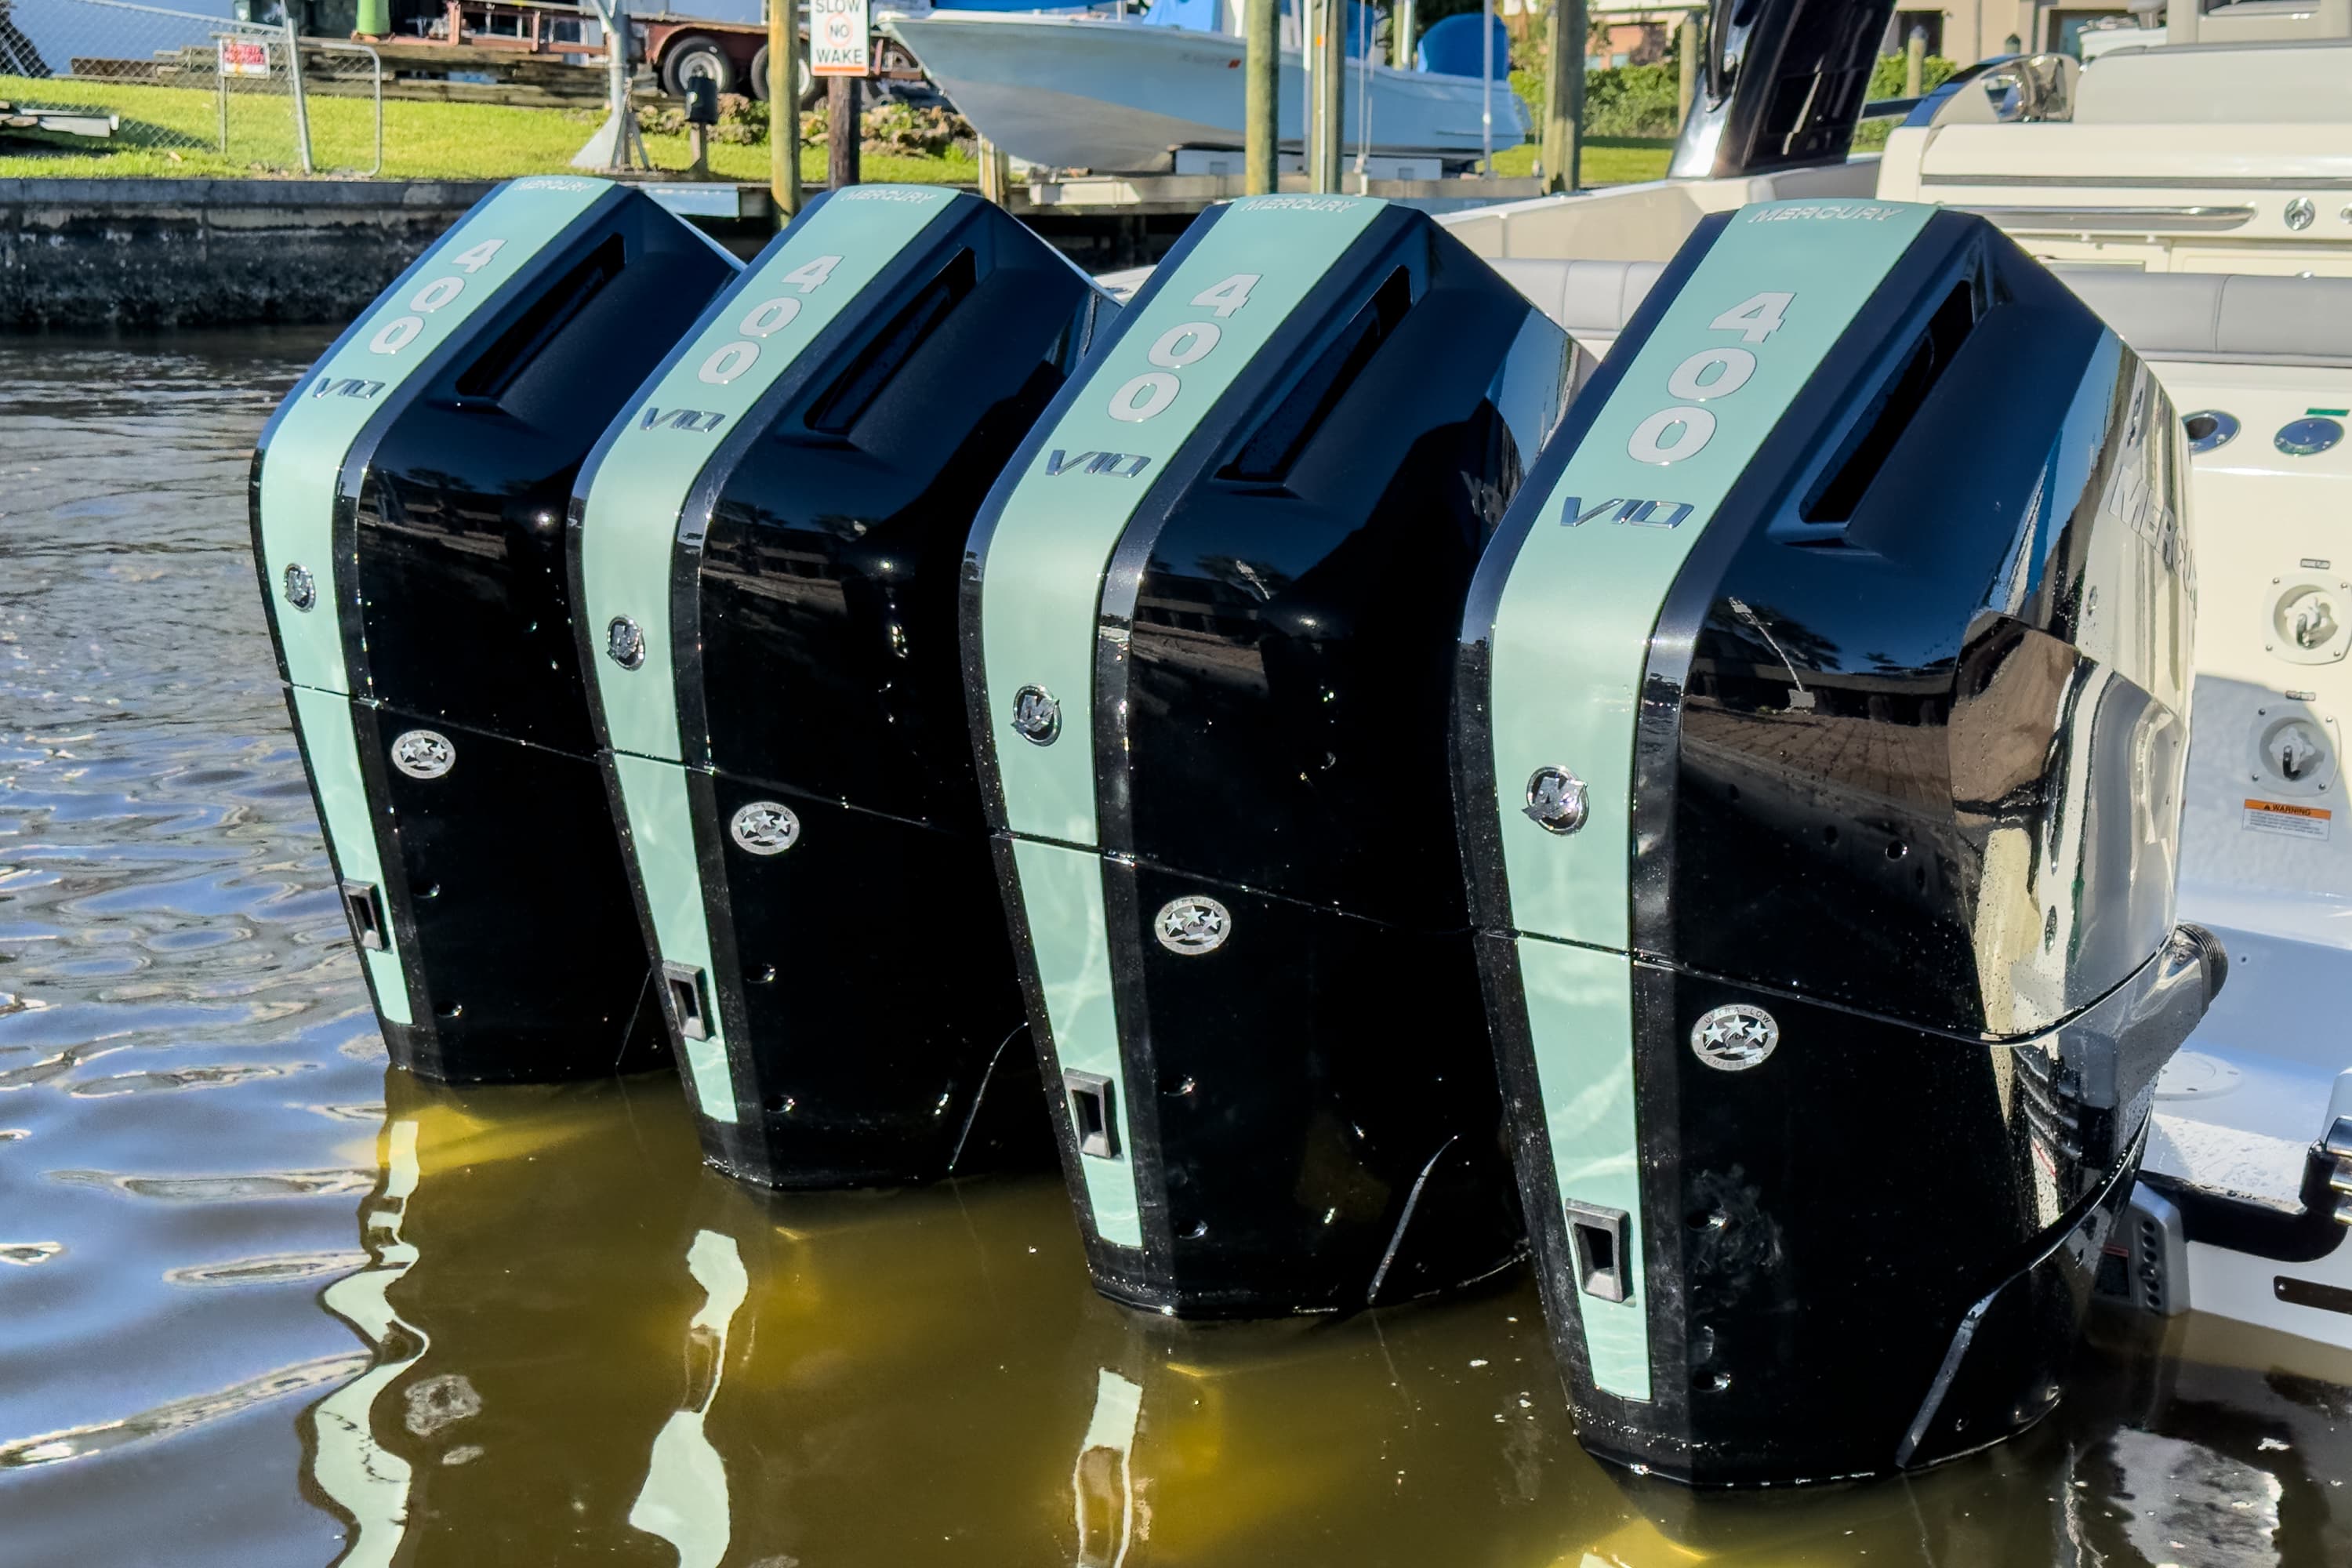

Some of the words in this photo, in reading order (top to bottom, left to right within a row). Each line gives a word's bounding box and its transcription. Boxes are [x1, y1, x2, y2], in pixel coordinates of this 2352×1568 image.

[815, 0, 860, 13] SLOW
[829, 24, 849, 38] NO
[816, 49, 863, 64] WAKE
[1240, 198, 1360, 212] MERCURY
[1748, 206, 1905, 223] MERCURY
[368, 238, 508, 355] 400
[698, 255, 845, 384] 400
[1107, 274, 1263, 423] 400
[1627, 292, 1797, 466] 400
[640, 407, 726, 433] V10
[1045, 449, 1152, 478] V10
[1559, 496, 1695, 529] V10
[2108, 464, 2198, 616] MERCU
[2272, 804, 2311, 816] WARNING
[1704, 1053, 1763, 1067] EMISSI
